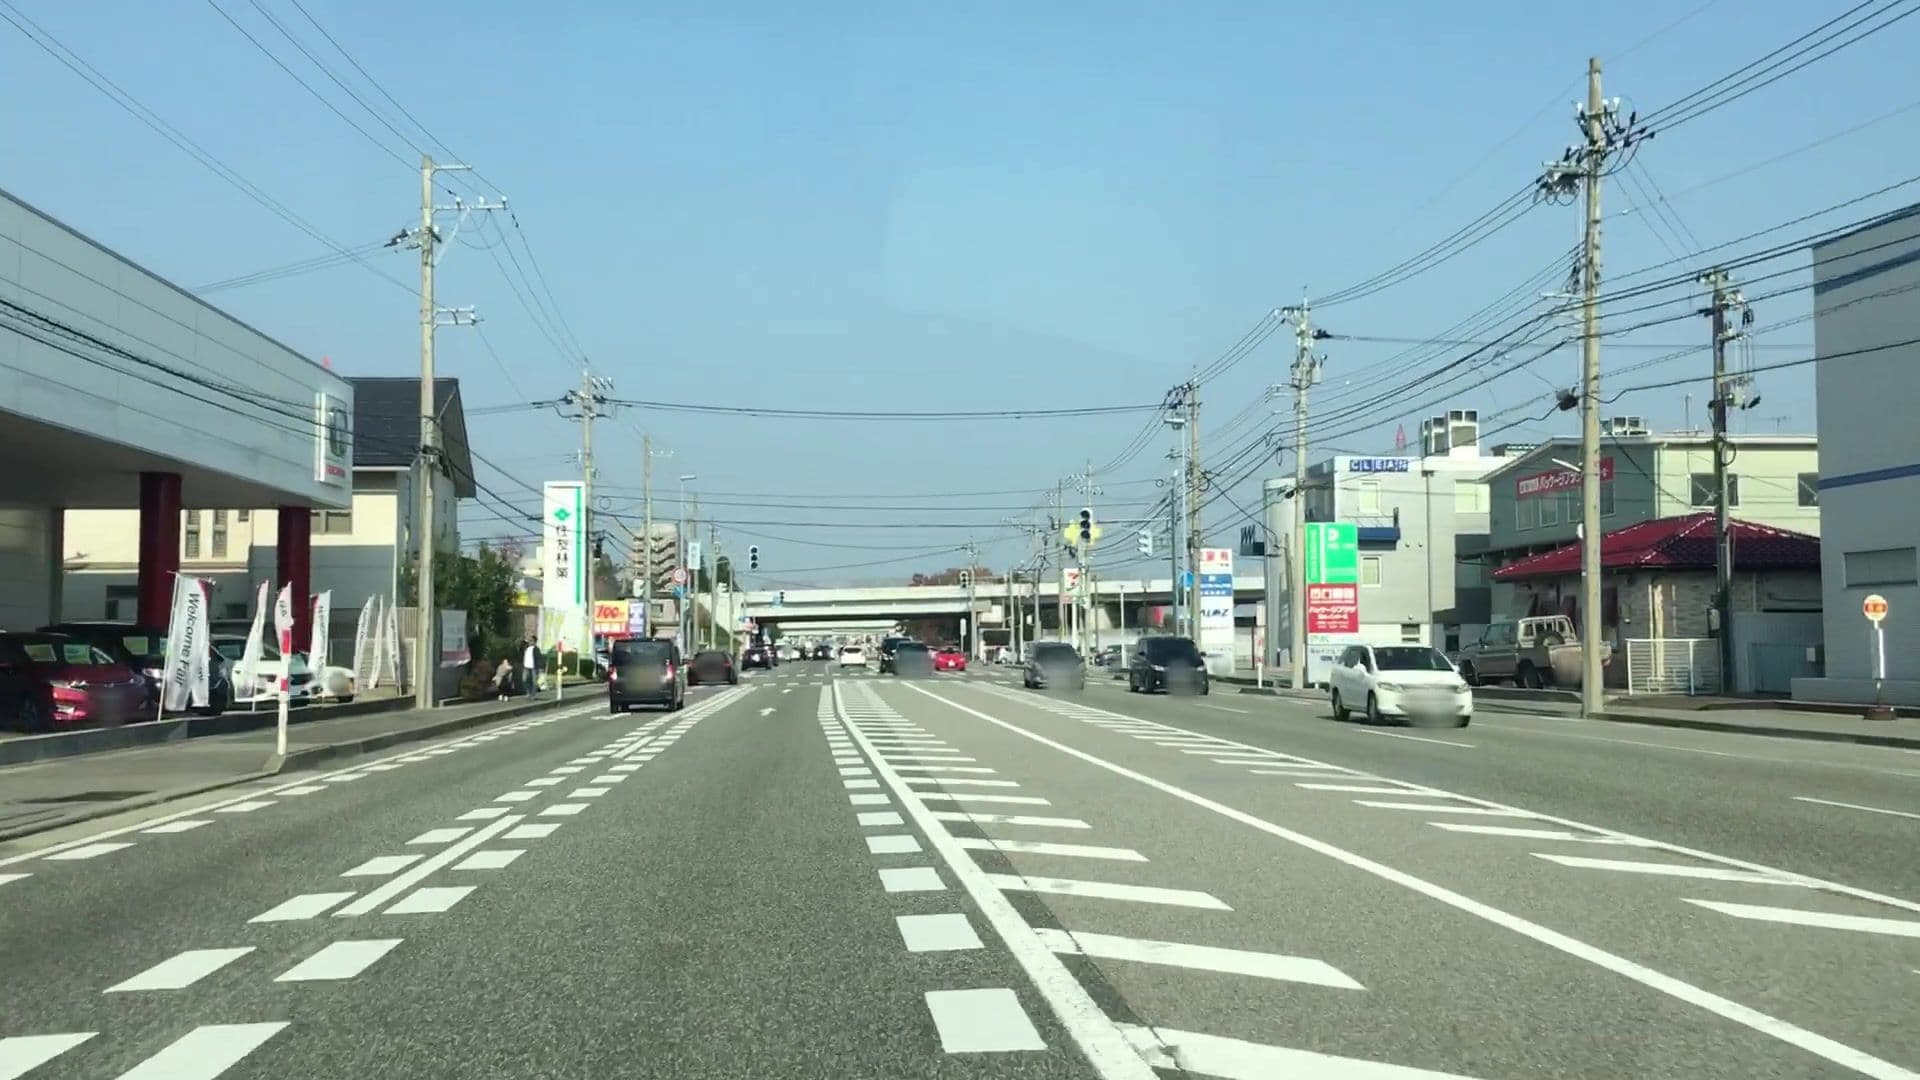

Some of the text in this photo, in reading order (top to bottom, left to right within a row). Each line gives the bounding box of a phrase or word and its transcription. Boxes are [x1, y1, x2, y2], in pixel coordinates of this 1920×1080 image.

[1351, 459, 1408, 471] CLEAN
[175, 592, 200, 687] Welcome Fair
